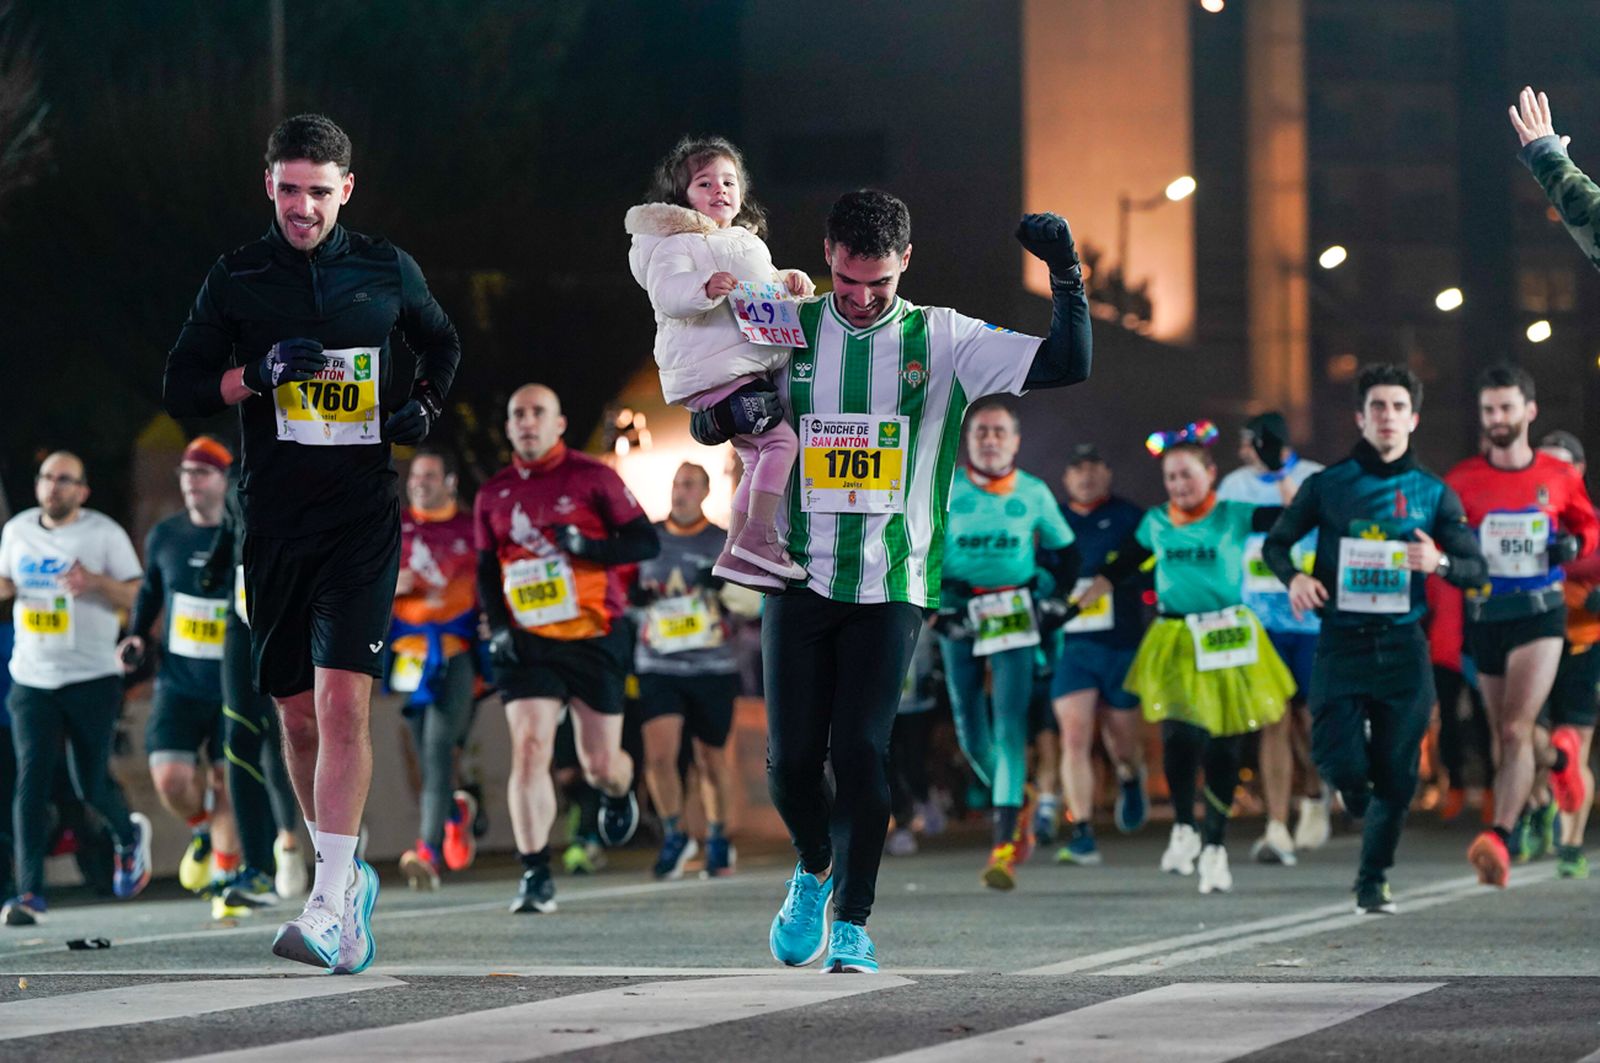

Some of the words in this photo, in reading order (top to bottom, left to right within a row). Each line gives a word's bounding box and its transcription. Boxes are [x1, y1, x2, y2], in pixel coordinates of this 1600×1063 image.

[747, 302, 775, 324] 19
[744, 327, 804, 346] IRENE
[333, 360, 346, 368] DE
[314, 369, 345, 381] NTÓN
[297, 382, 359, 412] 1760
[811, 421, 822, 431] 43
[823, 425, 854, 435] NOCHE
[857, 426, 869, 435] DE
[811, 436, 831, 447] SAN
[833, 435, 869, 447] ANTÓN
[825, 450, 881, 479] 1761
[1501, 539, 1533, 556] 950
[1350, 568, 1400, 587] 13413
